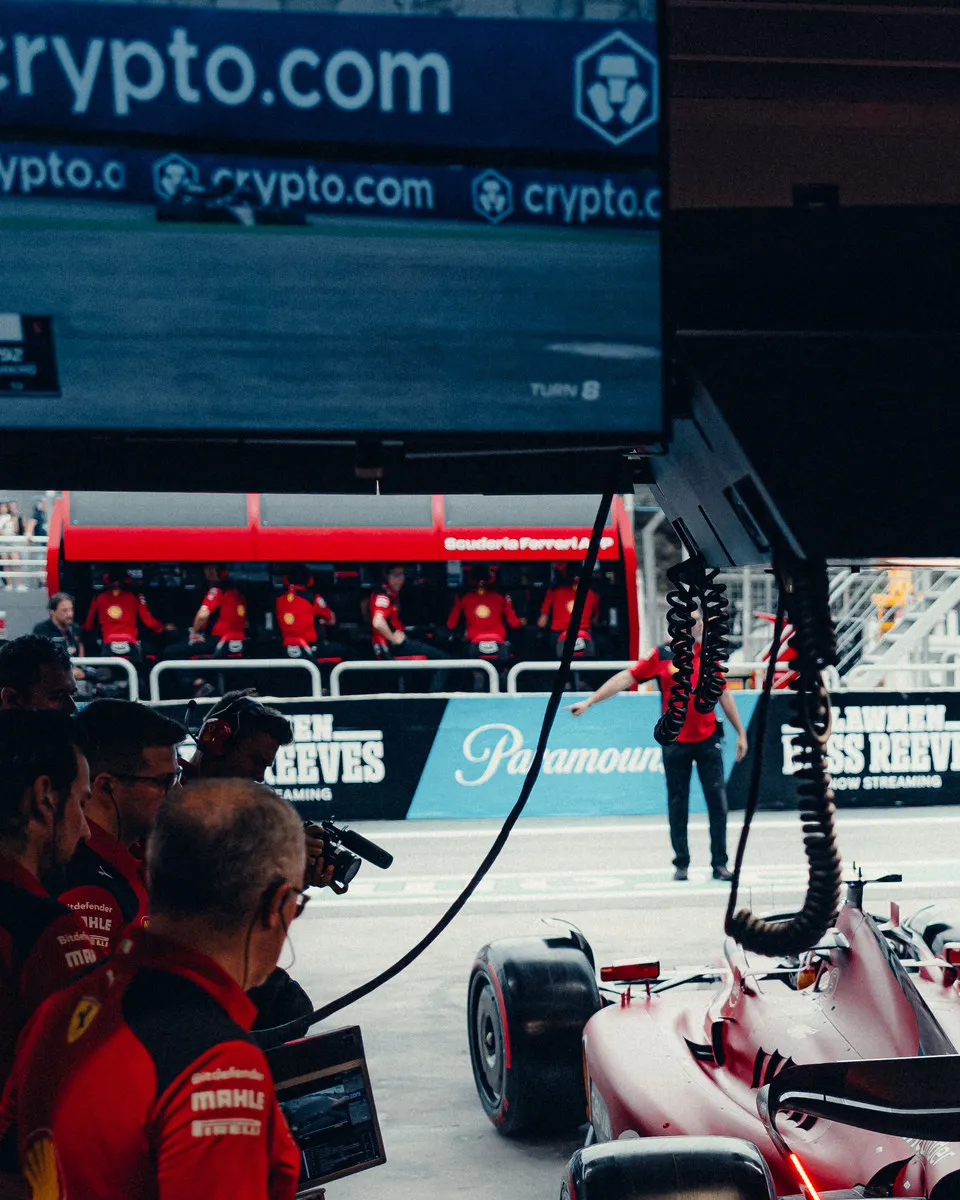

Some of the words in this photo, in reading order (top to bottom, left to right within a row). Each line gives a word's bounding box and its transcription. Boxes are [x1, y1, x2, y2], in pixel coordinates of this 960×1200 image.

[0, 27, 452, 116] rypto.com
[530, 382, 578, 398] TURN
[581, 379, 601, 401] 8
[519, 536, 578, 551] Ferrari
[862, 774, 943, 791] STREAMING
[191, 1088, 265, 1113] MAHLE
[191, 1117, 262, 1138] PIRELLI
